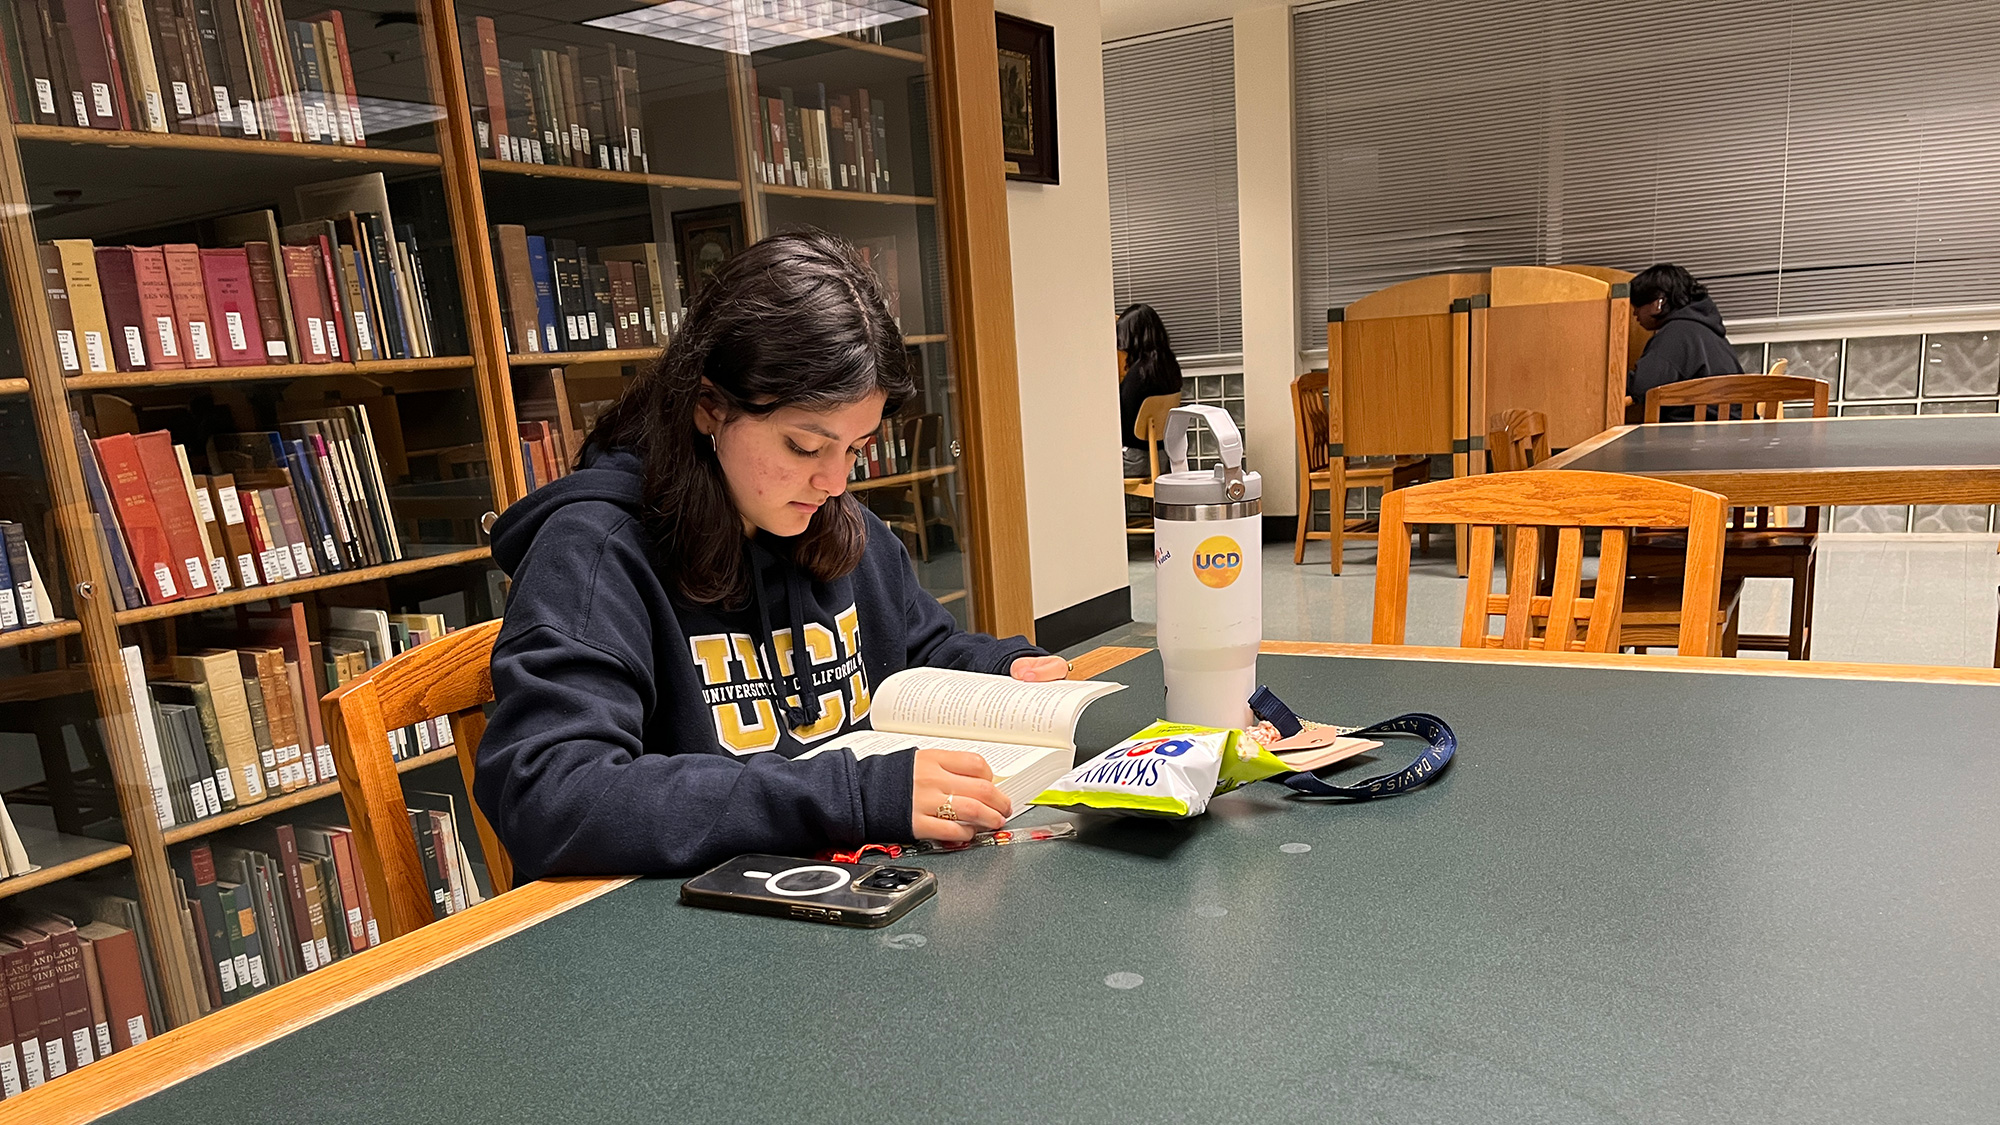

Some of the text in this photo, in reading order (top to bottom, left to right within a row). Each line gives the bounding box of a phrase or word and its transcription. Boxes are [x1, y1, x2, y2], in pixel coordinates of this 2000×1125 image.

[1196, 552, 1240, 569] UCD
[53, 946, 78, 960] LAND
[55, 961, 81, 974] WINE
